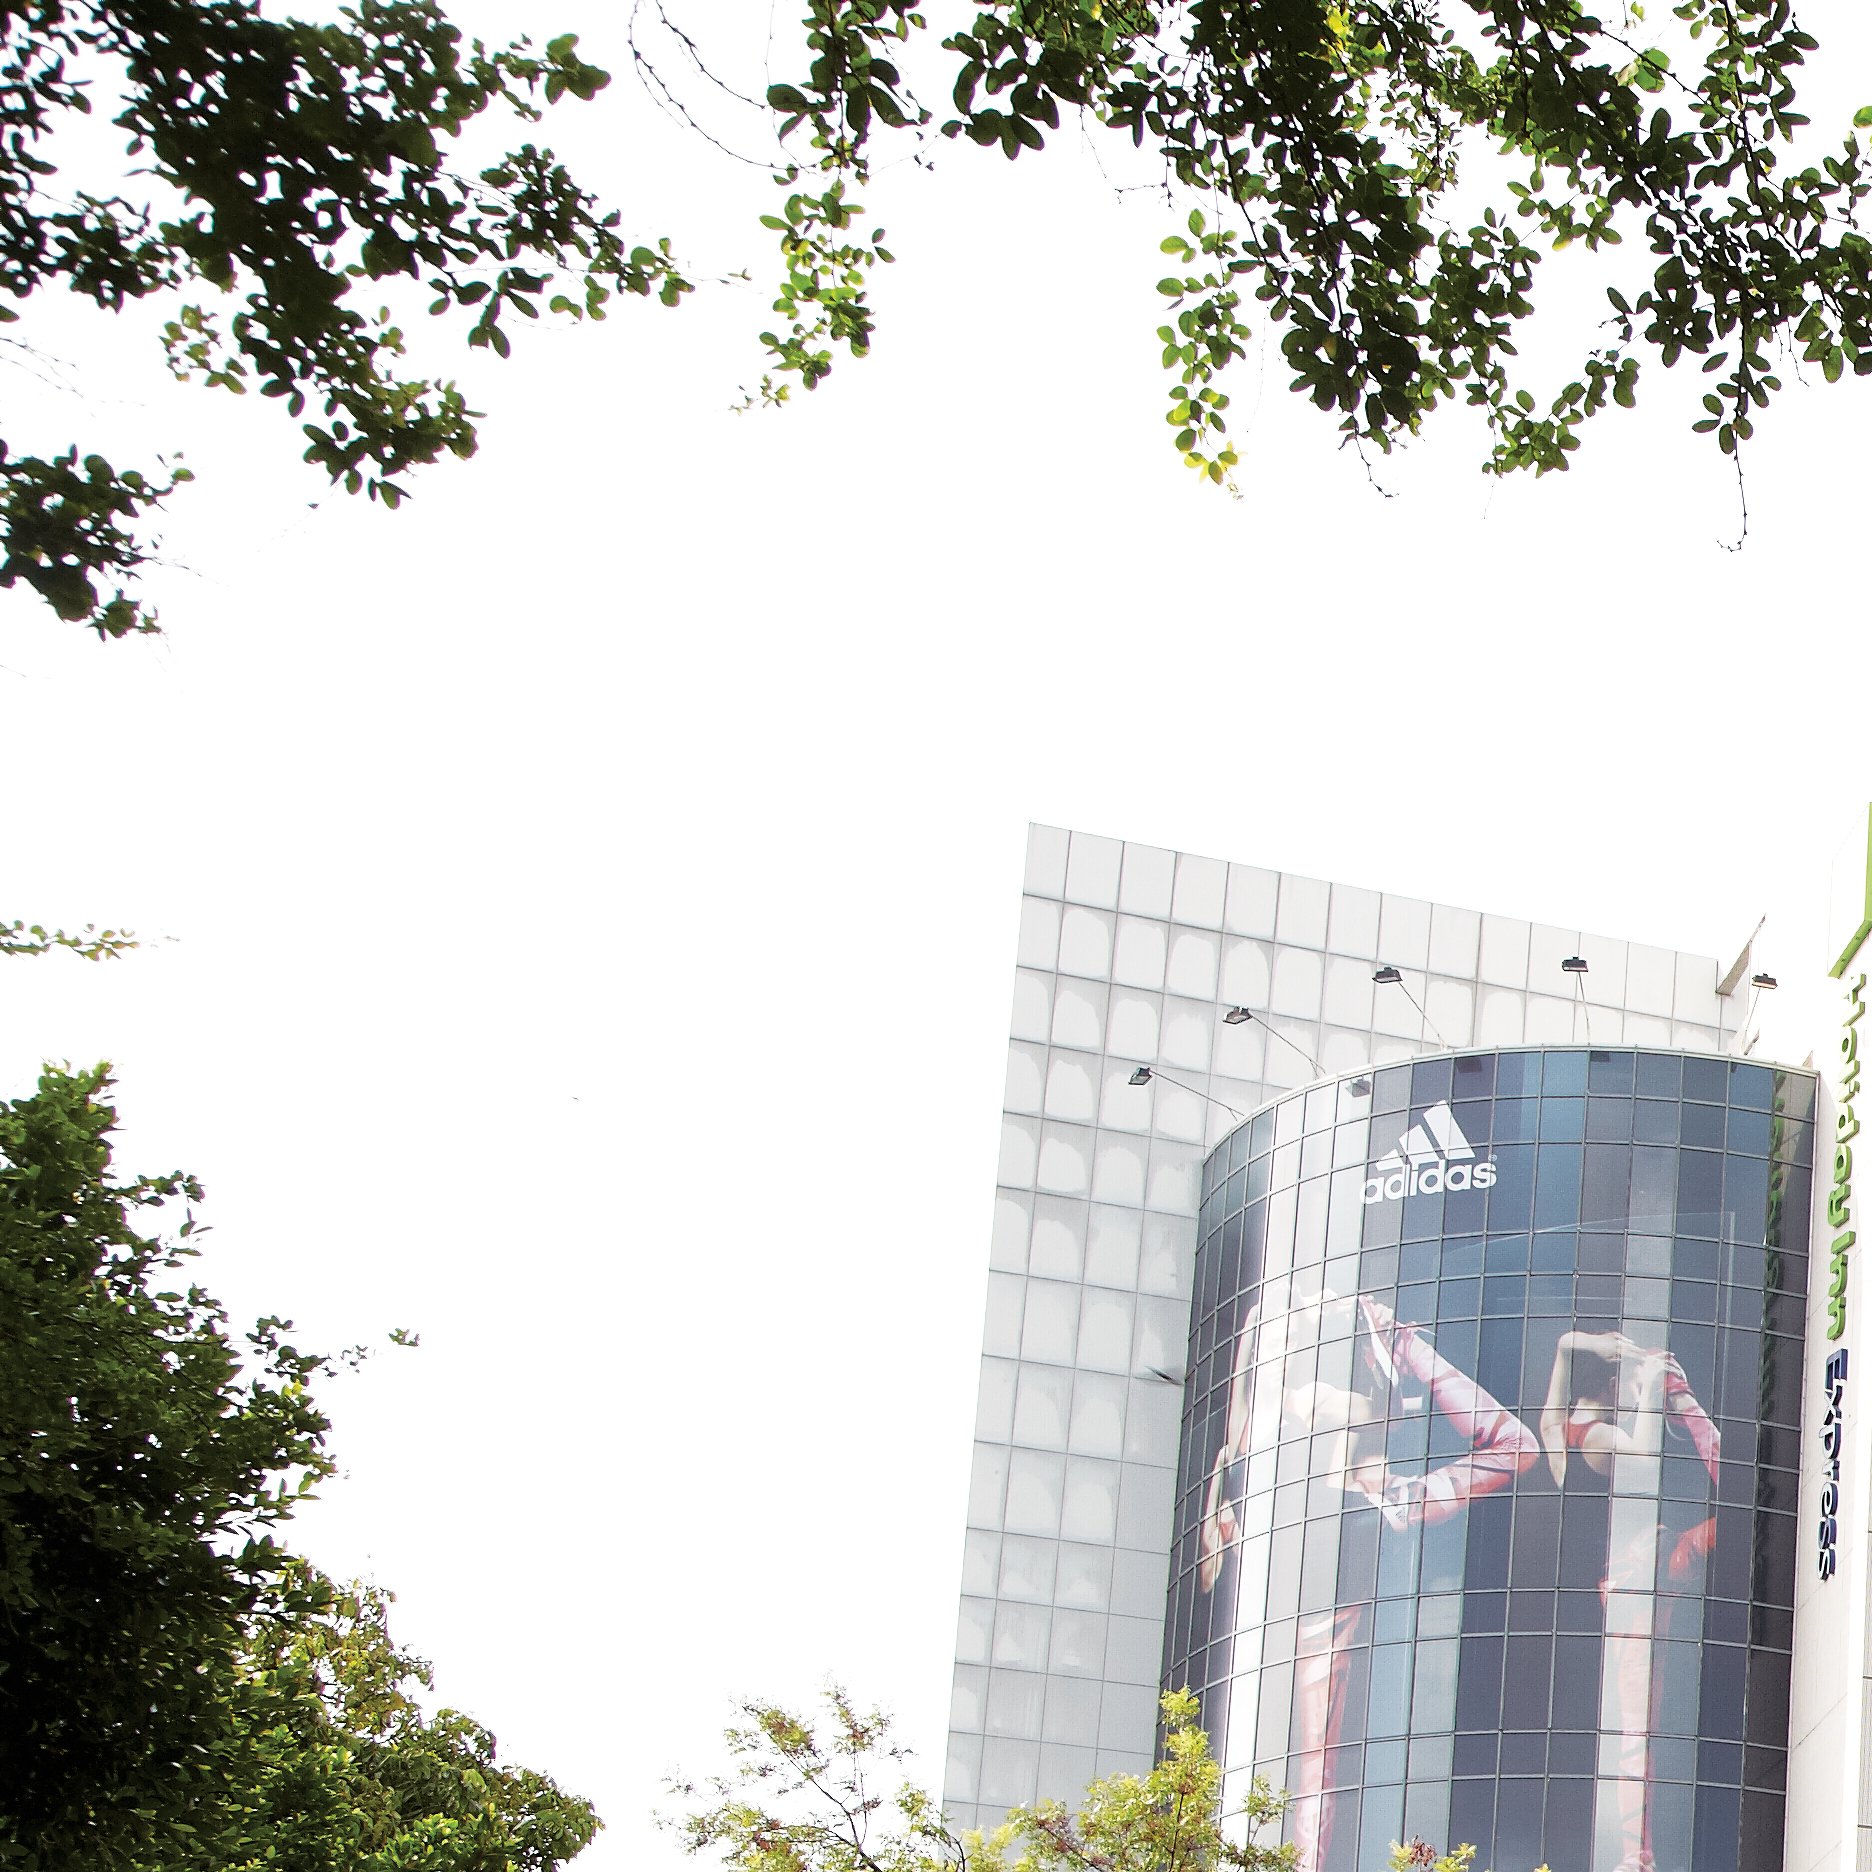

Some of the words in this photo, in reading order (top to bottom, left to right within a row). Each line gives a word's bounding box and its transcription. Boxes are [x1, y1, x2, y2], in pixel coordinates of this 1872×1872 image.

[1359, 1157, 1497, 1205] adidas
[1827, 974, 1867, 1228] Holiday
[1827, 1231, 1856, 1341] Inn
[1815, 1348, 1848, 1582] Express
